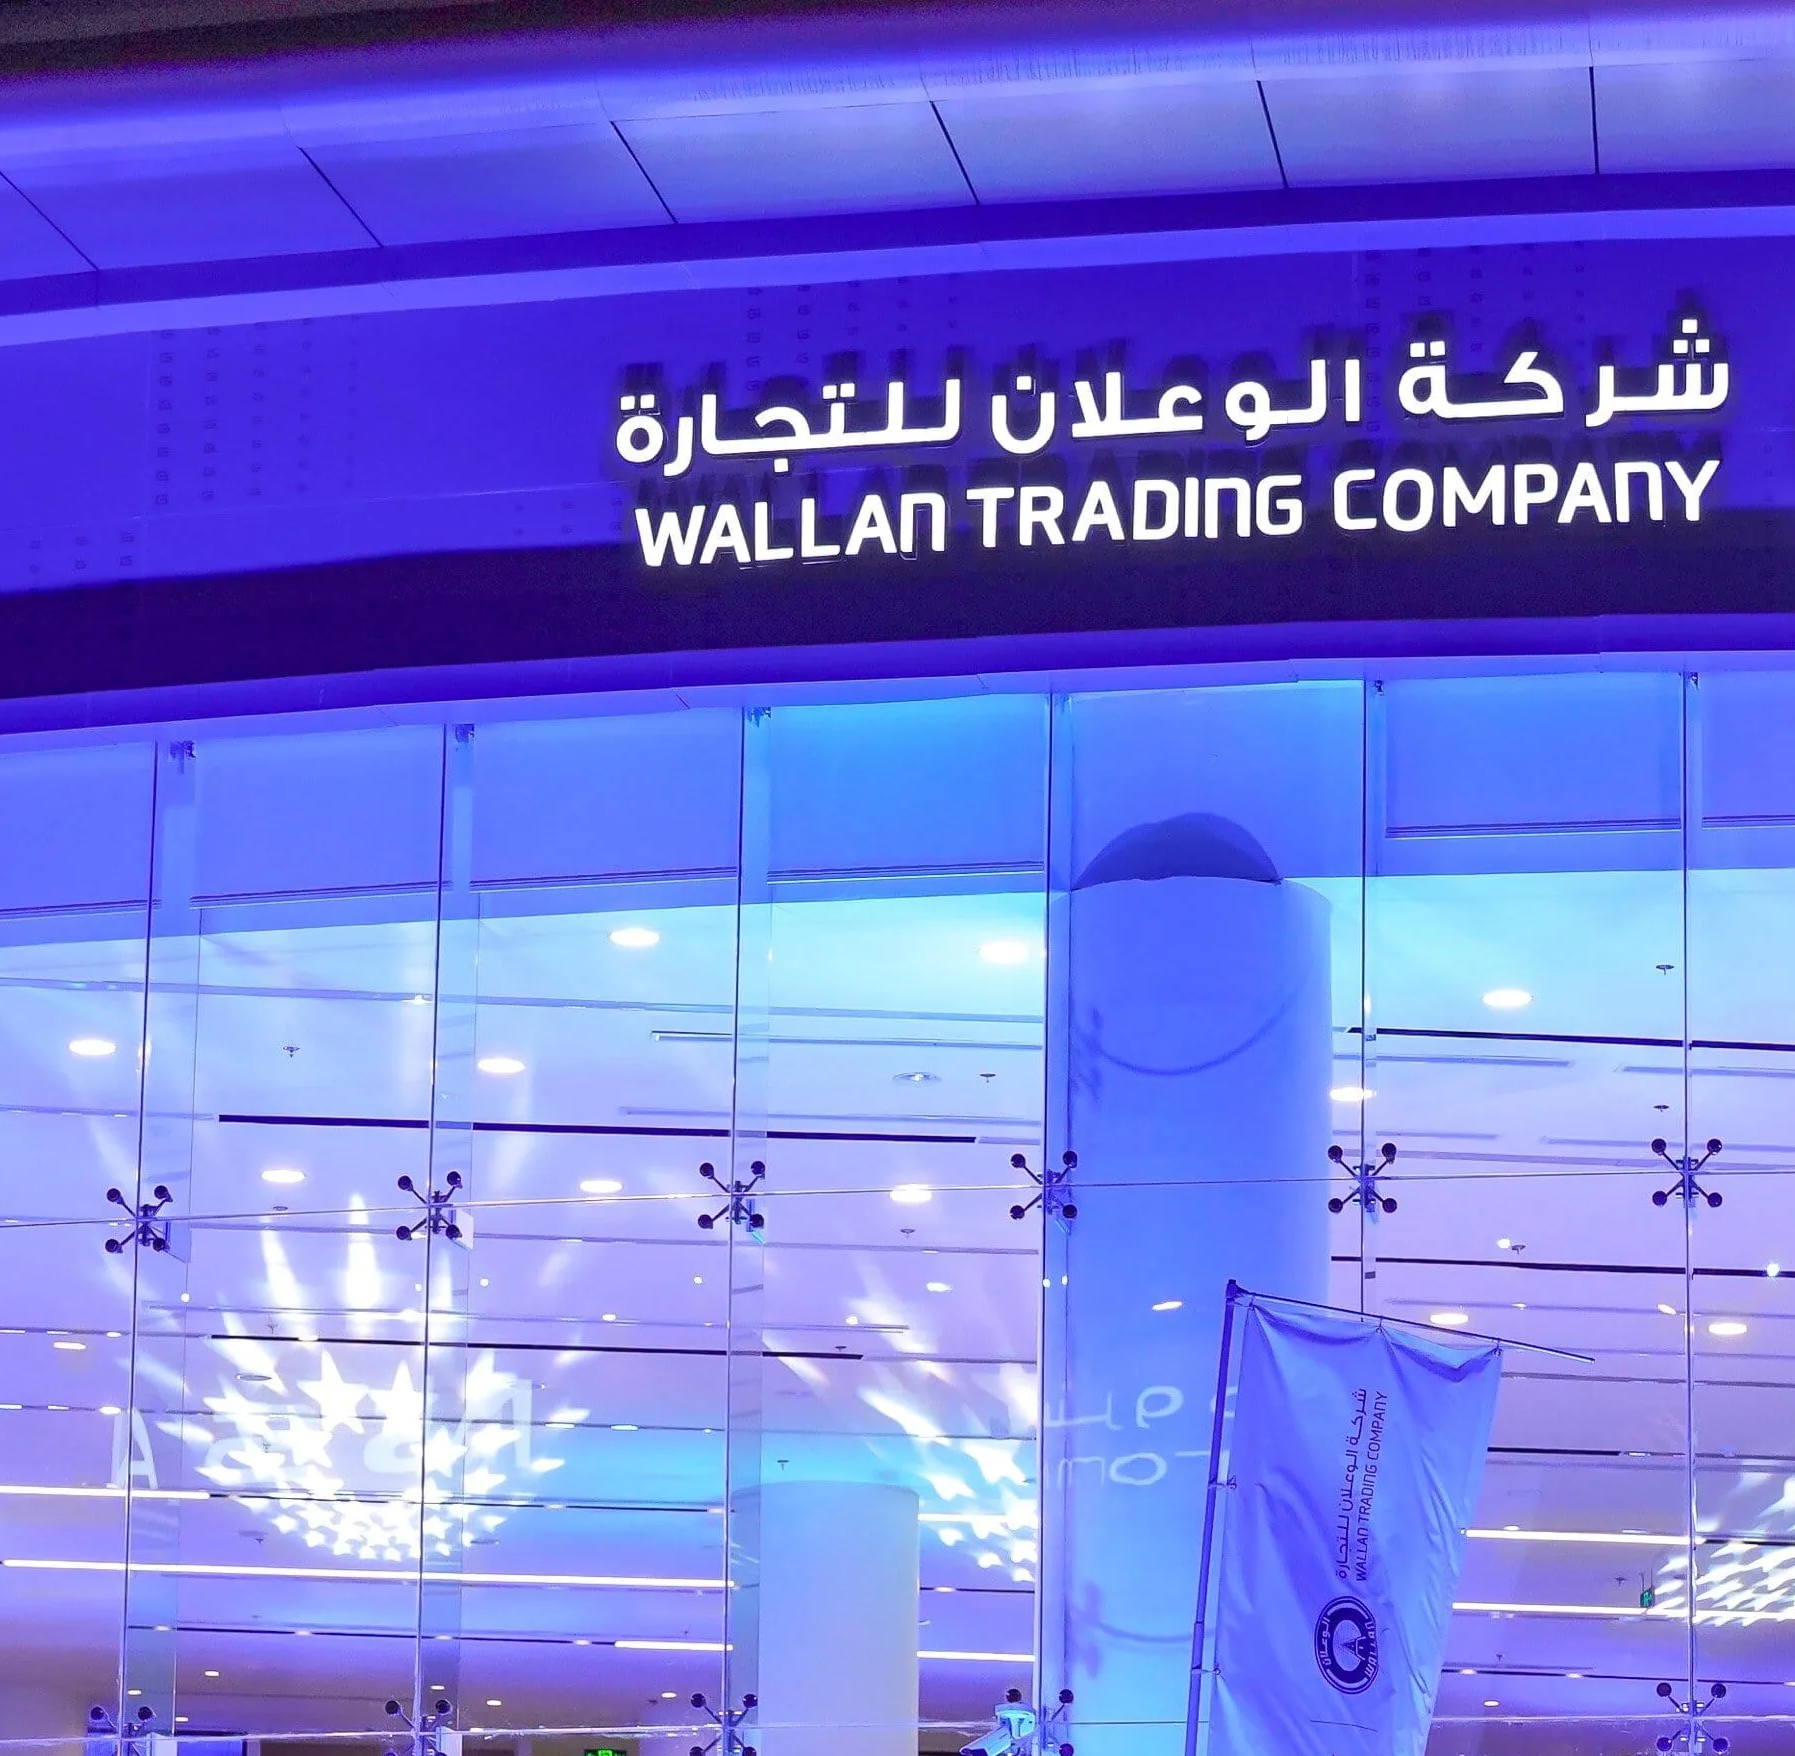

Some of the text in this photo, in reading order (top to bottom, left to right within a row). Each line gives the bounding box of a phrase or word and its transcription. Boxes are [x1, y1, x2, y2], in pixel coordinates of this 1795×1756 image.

[615, 317, 1730, 477] شركة الوعلان للتجارة
[634, 459, 1721, 568] WALLAN TRADING COMPANY
[1335, 1388, 1367, 1579] شركة الوعلان للتجارة
[1356, 1391, 1389, 1582] WALLAN TRADING COMPANY
